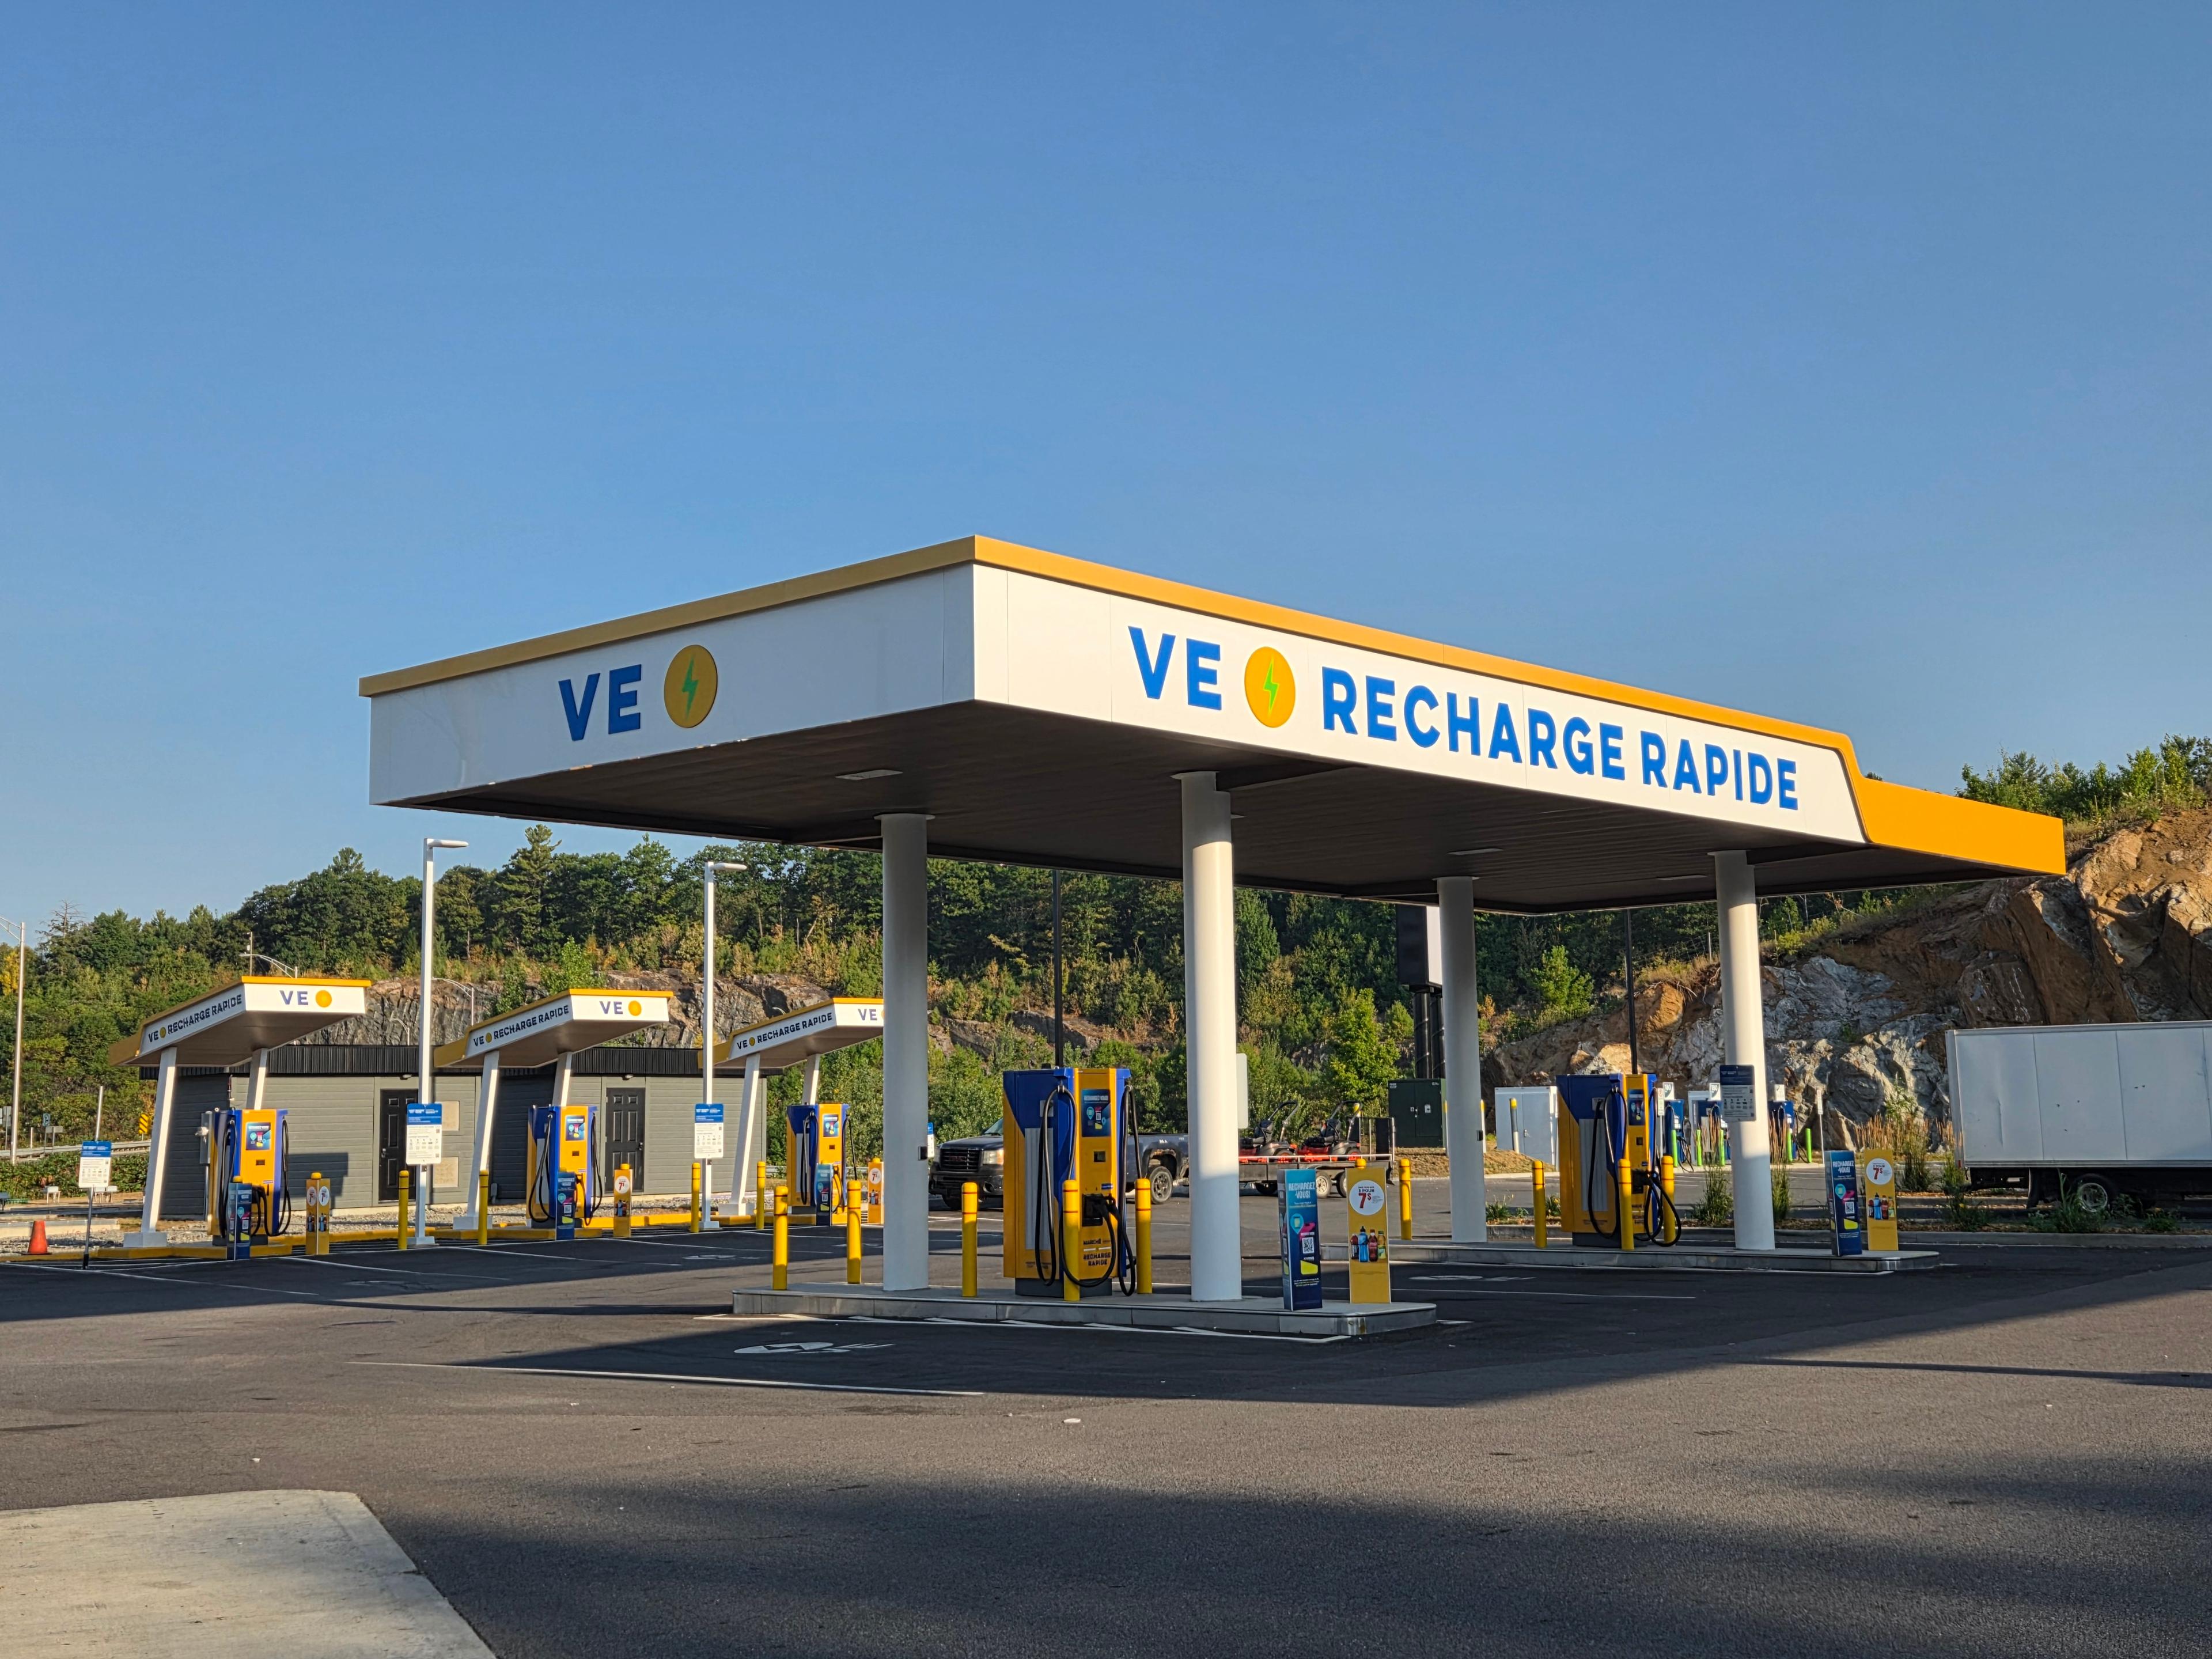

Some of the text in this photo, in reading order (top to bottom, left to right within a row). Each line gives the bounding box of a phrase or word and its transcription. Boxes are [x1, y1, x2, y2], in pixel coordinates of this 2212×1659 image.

[558, 664, 642, 741] VE
[1127, 626, 1798, 811] VE RECHARGE RAPIDE
[279, 990, 309, 1006] VE
[599, 1001, 623, 1014] VE
[857, 1008, 877, 1021] VE
[147, 994, 243, 1043] VE RECHARGE RAPIDE
[473, 1005, 570, 1047] VE RECHARGE RAPIDE
[737, 1012, 833, 1050] VE RECHARGE RAPIDE
[1288, 1181, 1315, 1191] RECHARGEZ
